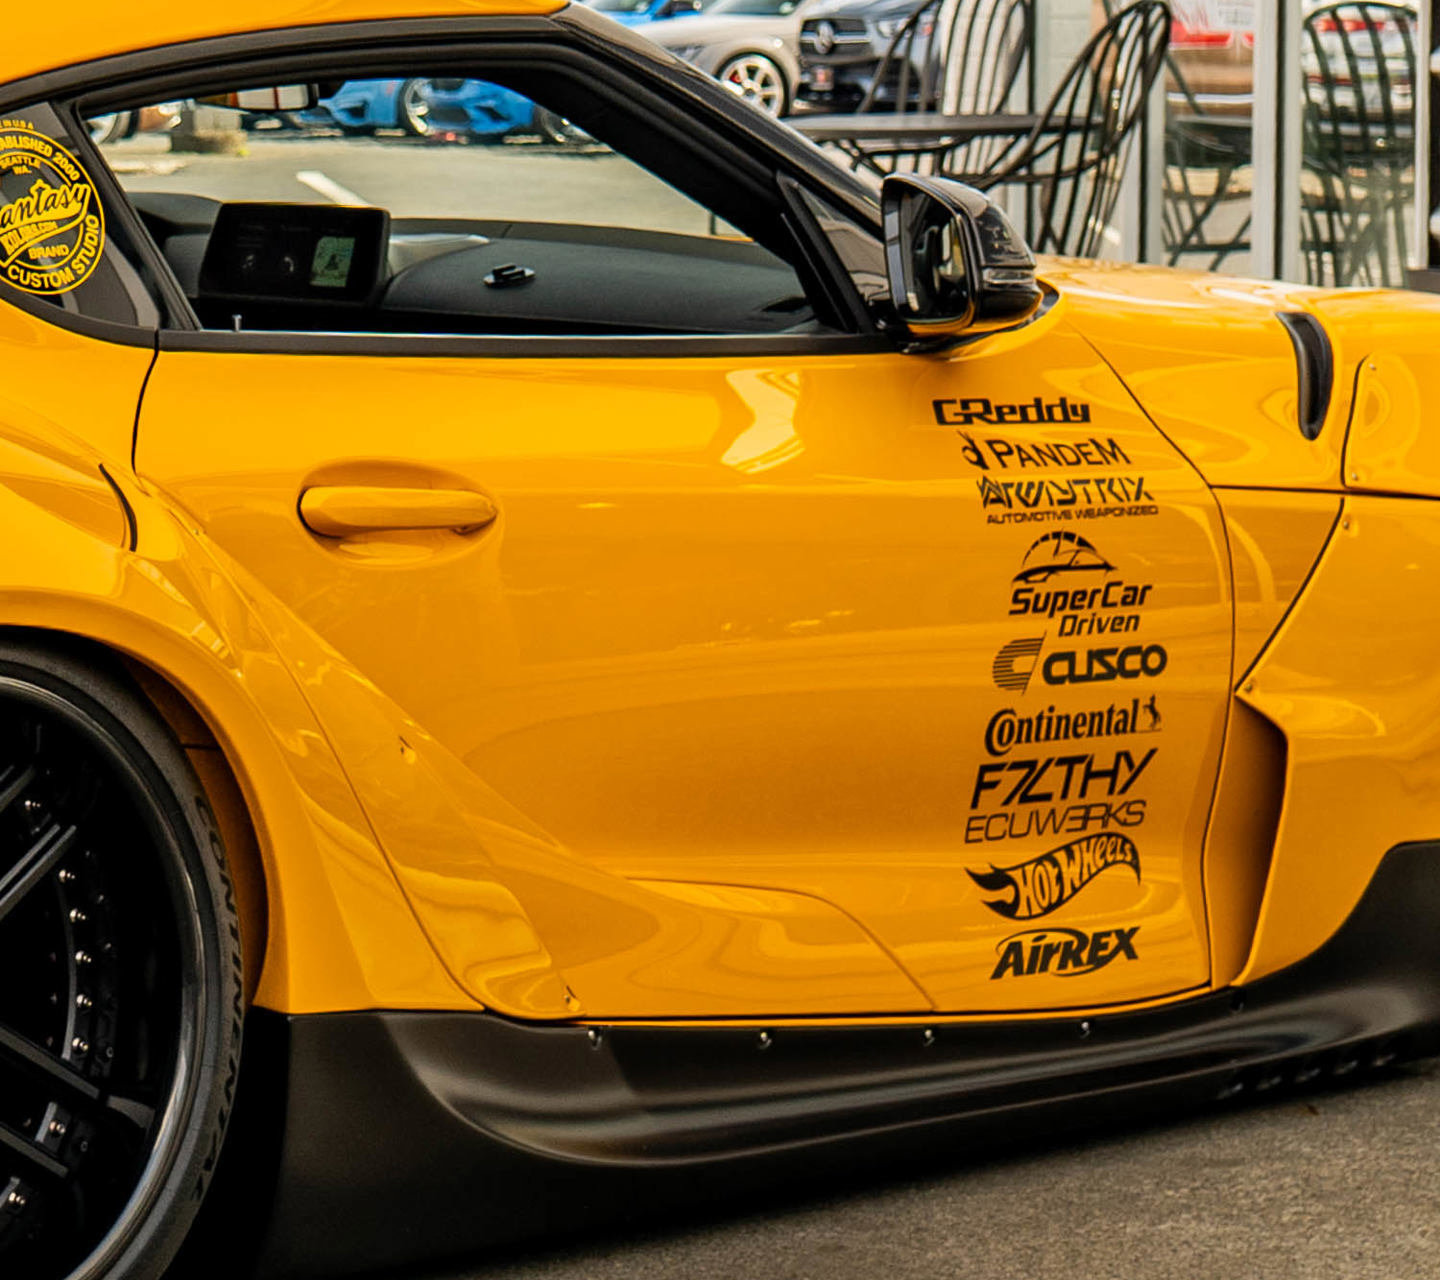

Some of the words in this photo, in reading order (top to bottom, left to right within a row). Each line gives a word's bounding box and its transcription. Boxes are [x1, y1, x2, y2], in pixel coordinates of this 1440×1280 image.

[0, 156, 40, 169] SEATTLE
[52, 151, 80, 181] 2000
[7, 265, 76, 289] CUSTOM
[70, 214, 100, 276] STUDIO
[28, 244, 70, 260] BRAND
[932, 397, 1092, 426] GReddy
[984, 437, 1131, 469] PANDEM
[987, 509, 1072, 525] AUTOMOTIVE
[1075, 505, 1159, 520] WEAPONIZED
[1008, 580, 1153, 619] SuperCar
[1057, 611, 1141, 638] Driven
[1042, 644, 1168, 686] CUSCO
[984, 698, 1140, 757] Continental
[964, 799, 1148, 844] ECUWERKS
[191, 795, 243, 1203] CONTINENTAL
